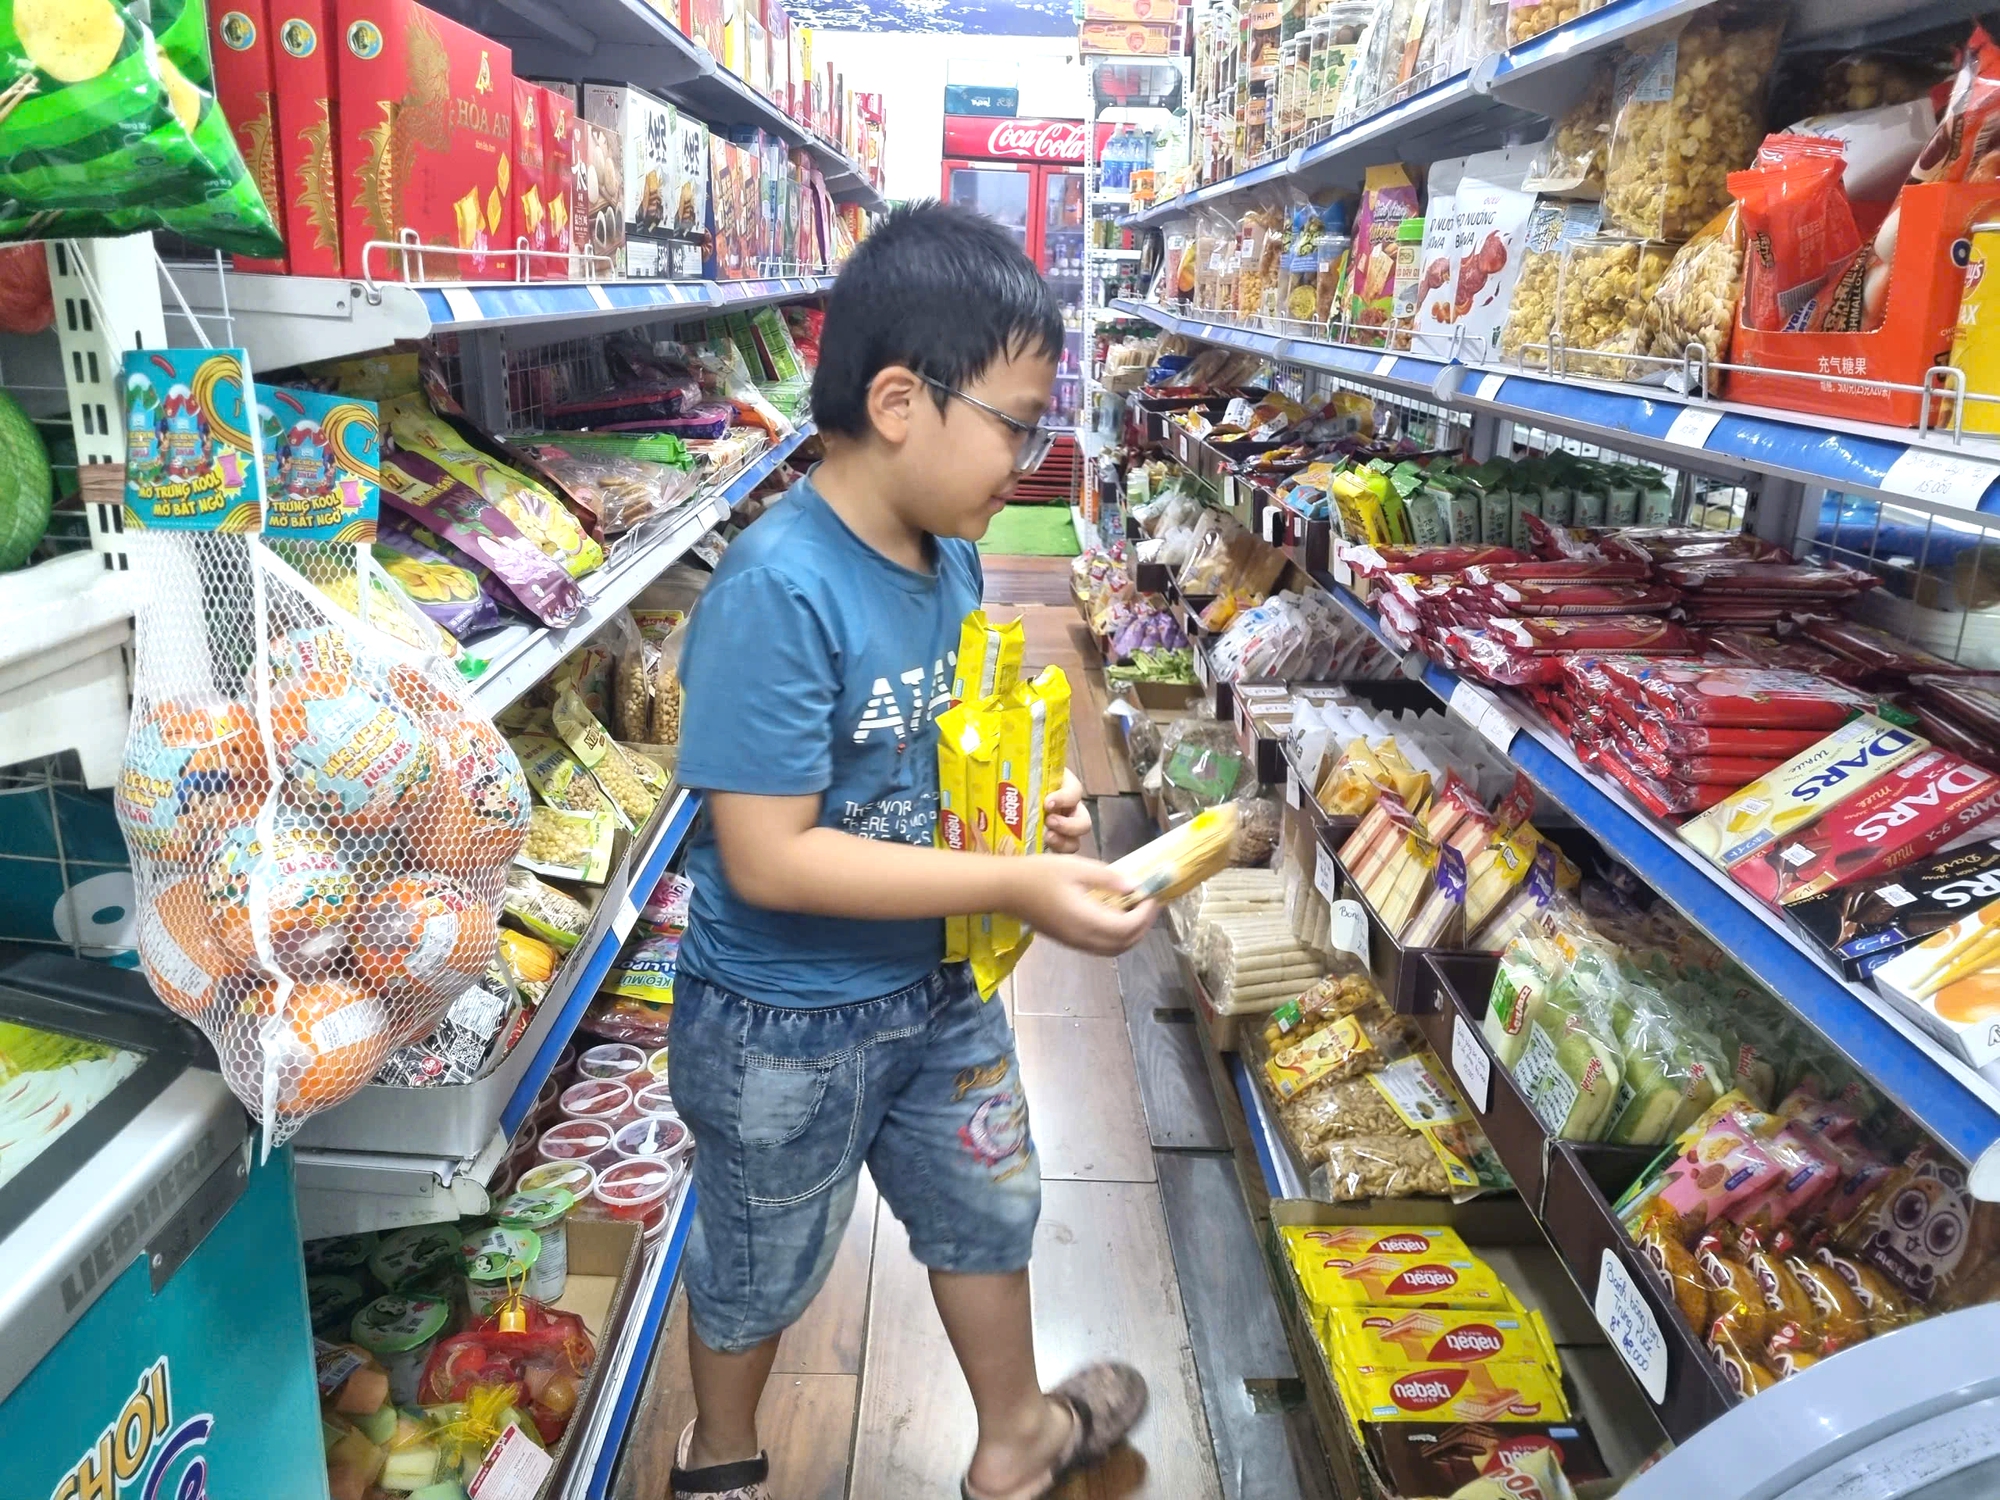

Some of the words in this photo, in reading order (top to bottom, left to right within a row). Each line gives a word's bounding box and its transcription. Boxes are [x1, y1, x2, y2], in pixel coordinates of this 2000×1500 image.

[456, 95, 491, 135] HÒA
[493, 113, 511, 141] AN
[987, 120, 1086, 159] Coca-Cola
[1818, 356, 1867, 376] 充气糖果
[192, 472, 222, 494] KOOL
[312, 492, 340, 511] KOOL
[1791, 728, 1917, 802] DARS
[1004, 786, 1019, 826] nabati
[1853, 764, 1993, 843] DARS
[1932, 853, 1982, 872] Dark
[60, 1130, 217, 1314] LIEBHERR
[1378, 1240, 1428, 1252] nabati
[1403, 1271, 1455, 1286] nabati
[1446, 1333, 1502, 1352] nabati
[1393, 1380, 1452, 1399] nabati
